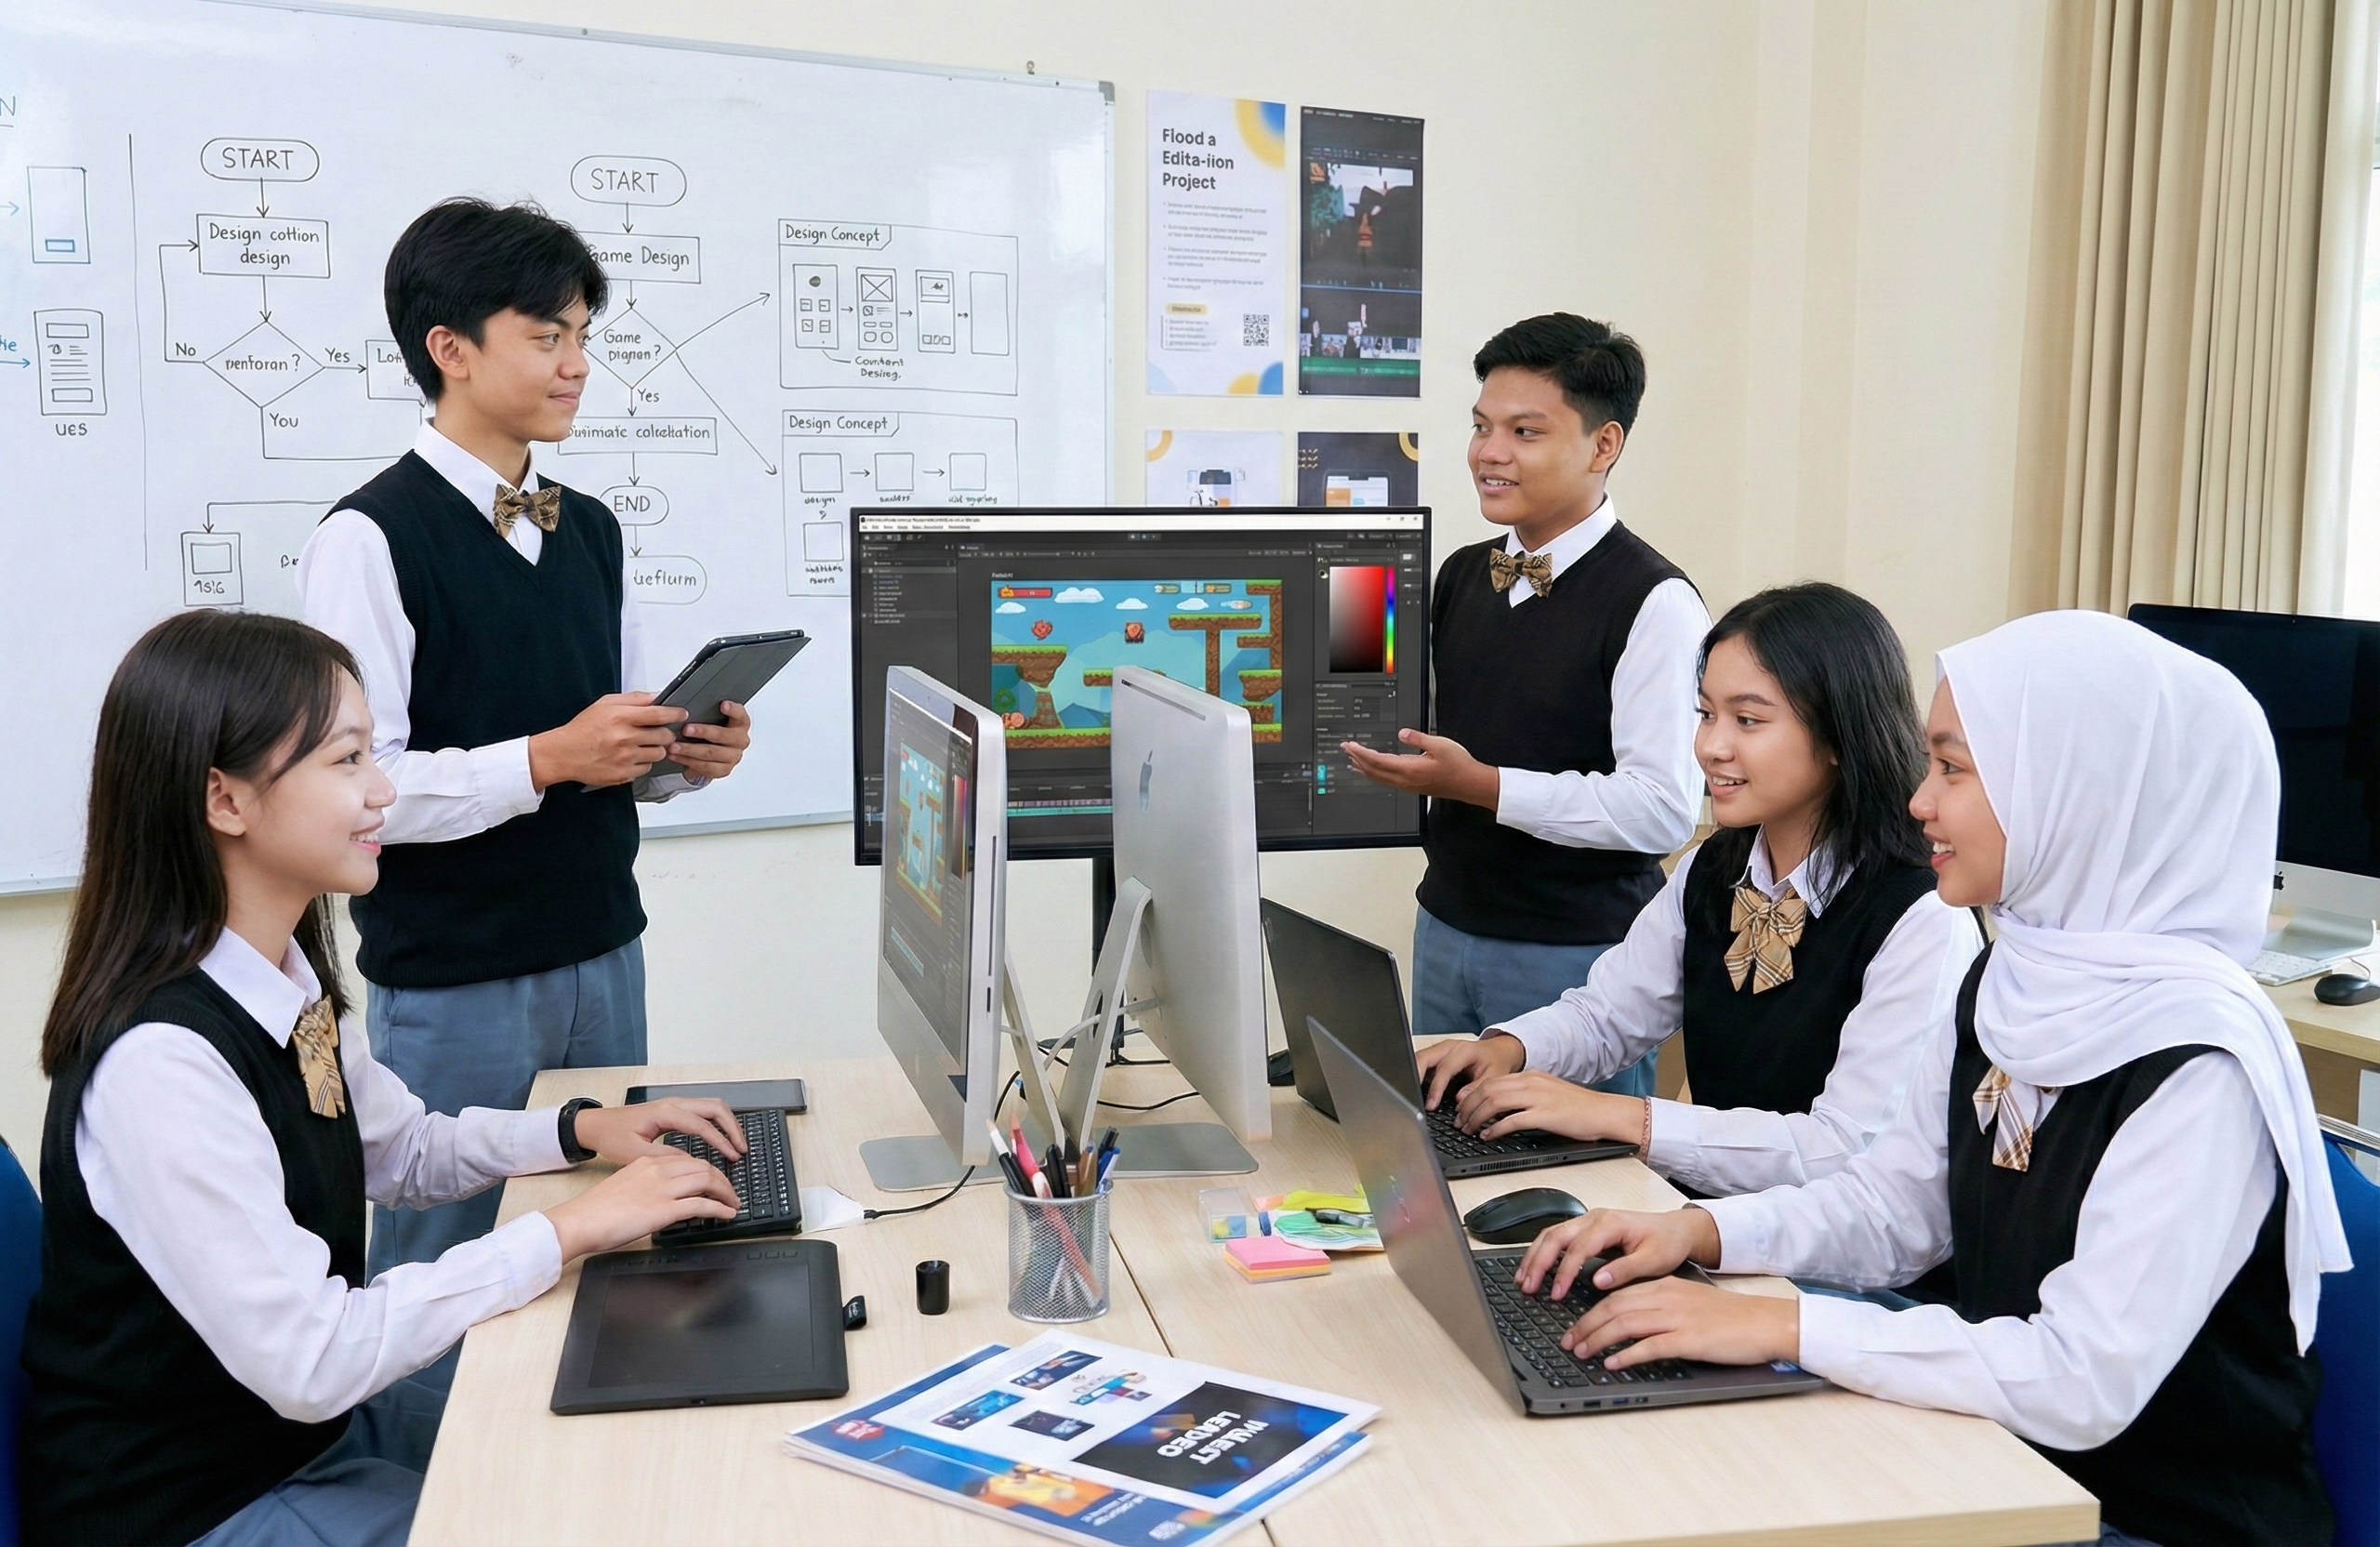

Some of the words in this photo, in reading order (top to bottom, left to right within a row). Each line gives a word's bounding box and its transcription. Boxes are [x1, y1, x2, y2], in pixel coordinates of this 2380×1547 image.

[1162, 127, 1205, 146] Flood
[1208, 135, 1217, 147] a
[221, 146, 295, 171] START
[590, 167, 659, 193] START
[1162, 172, 1216, 192] Project
[209, 222, 261, 246] Design
[786, 223, 827, 245] Design
[830, 226, 880, 246] Concept
[240, 246, 291, 271] design
[641, 245, 690, 272] Design
[603, 328, 641, 344] Game
[175, 342, 197, 357] No
[324, 347, 350, 364] Yes
[637, 388, 660, 403] Yes
[269, 412, 299, 428] You
[789, 415, 831, 434] Design
[837, 416, 888, 434] Concept
[614, 495, 651, 513] END
